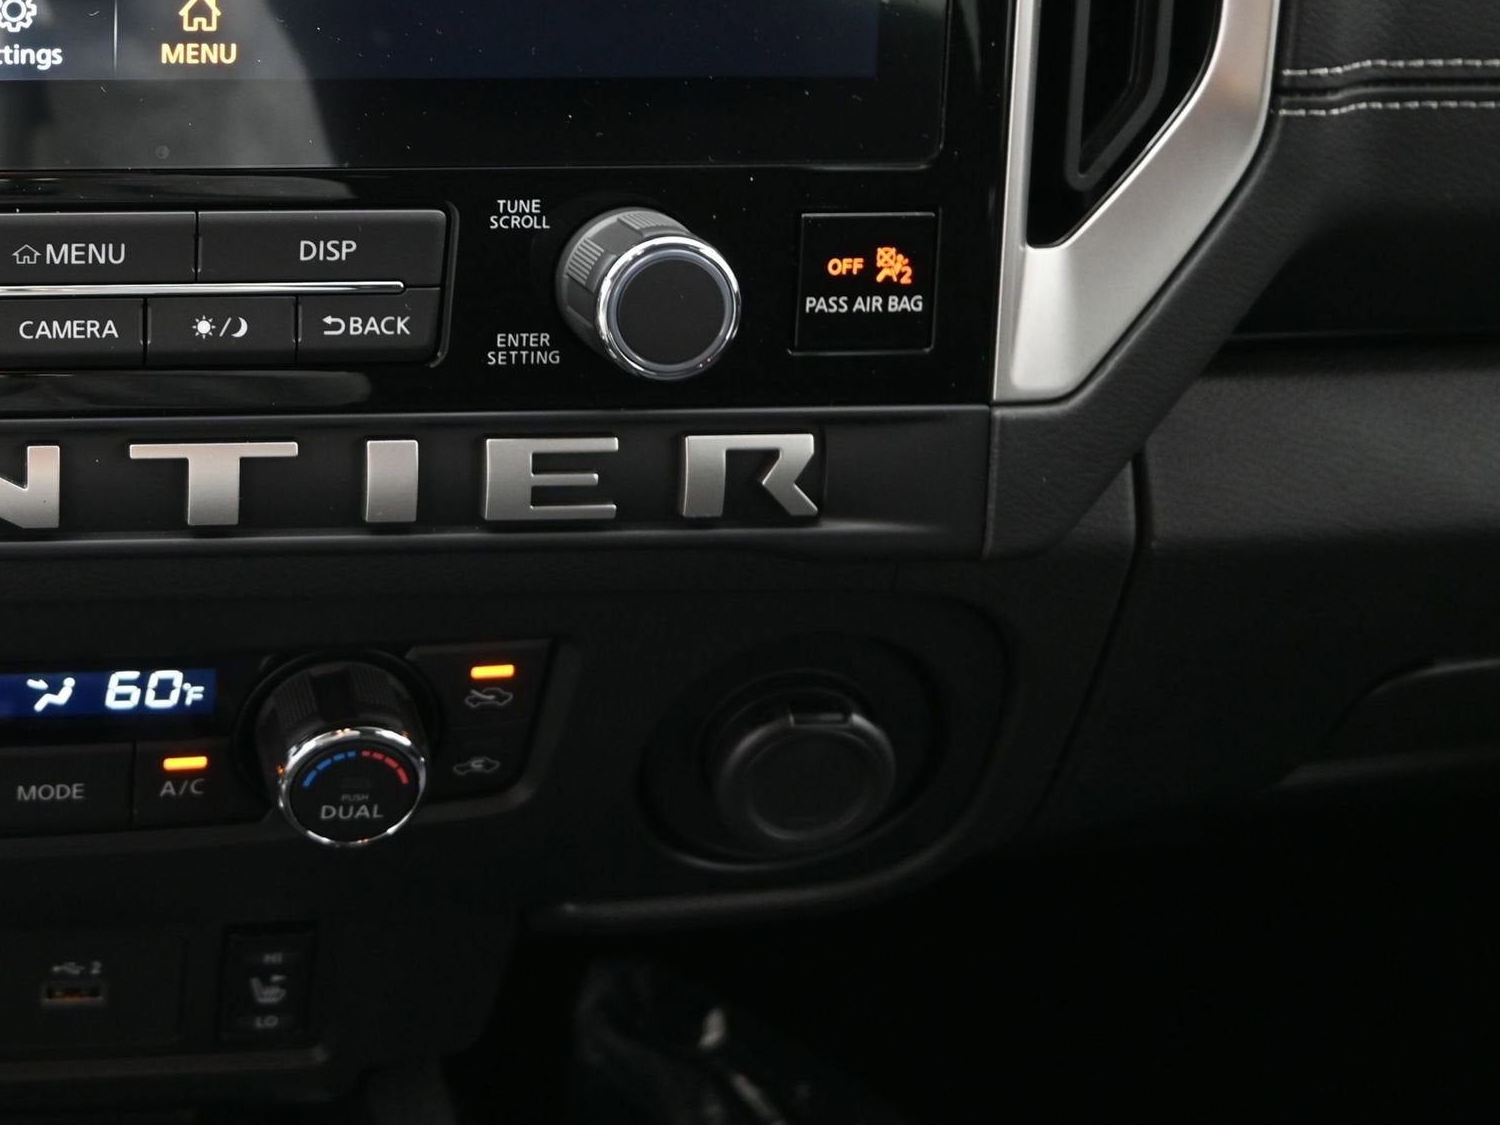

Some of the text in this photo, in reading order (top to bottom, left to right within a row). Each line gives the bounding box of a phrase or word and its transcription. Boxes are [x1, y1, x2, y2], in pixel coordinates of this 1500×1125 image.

[160, 42, 238, 65] MENU
[496, 199, 542, 214] TUNE
[489, 215, 551, 230] SCROLL
[45, 242, 127, 266] MENU
[299, 239, 358, 263] DISP
[827, 257, 865, 276] OFF
[805, 295, 924, 313] PASS AIR BAG
[18, 319, 119, 340] CAMERA
[349, 315, 411, 336] BACK
[496, 332, 551, 349] ENTER
[487, 350, 561, 366] SETTING
[16, 783, 85, 801] MODE
[159, 779, 205, 797] A/C
[319, 804, 384, 820] DUAL
